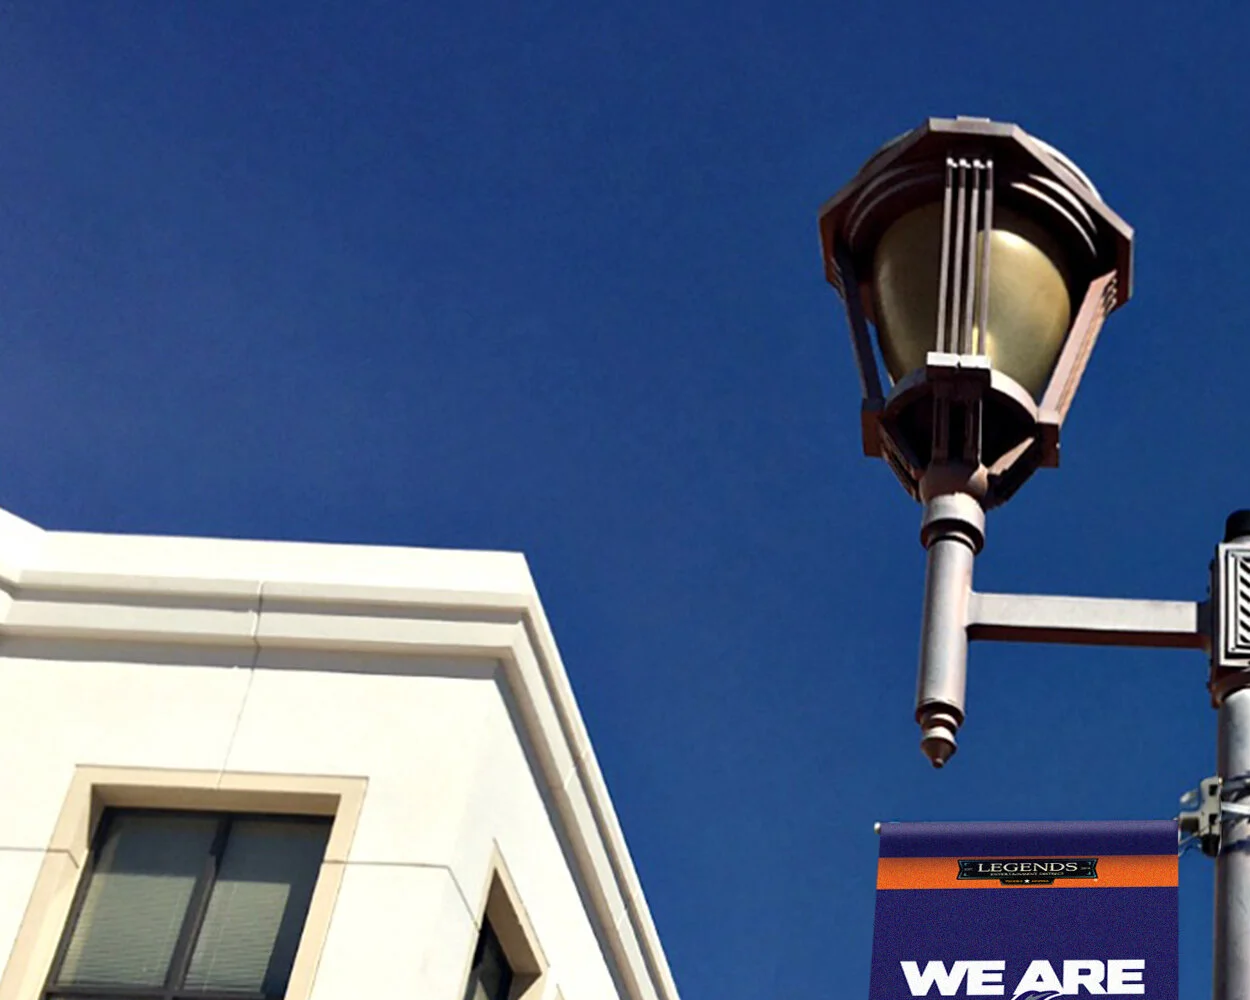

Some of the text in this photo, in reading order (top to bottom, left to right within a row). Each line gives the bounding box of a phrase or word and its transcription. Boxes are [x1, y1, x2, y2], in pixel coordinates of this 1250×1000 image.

[978, 862, 1078, 873] LEGENDS
[900, 958, 1146, 996] WE ARE
